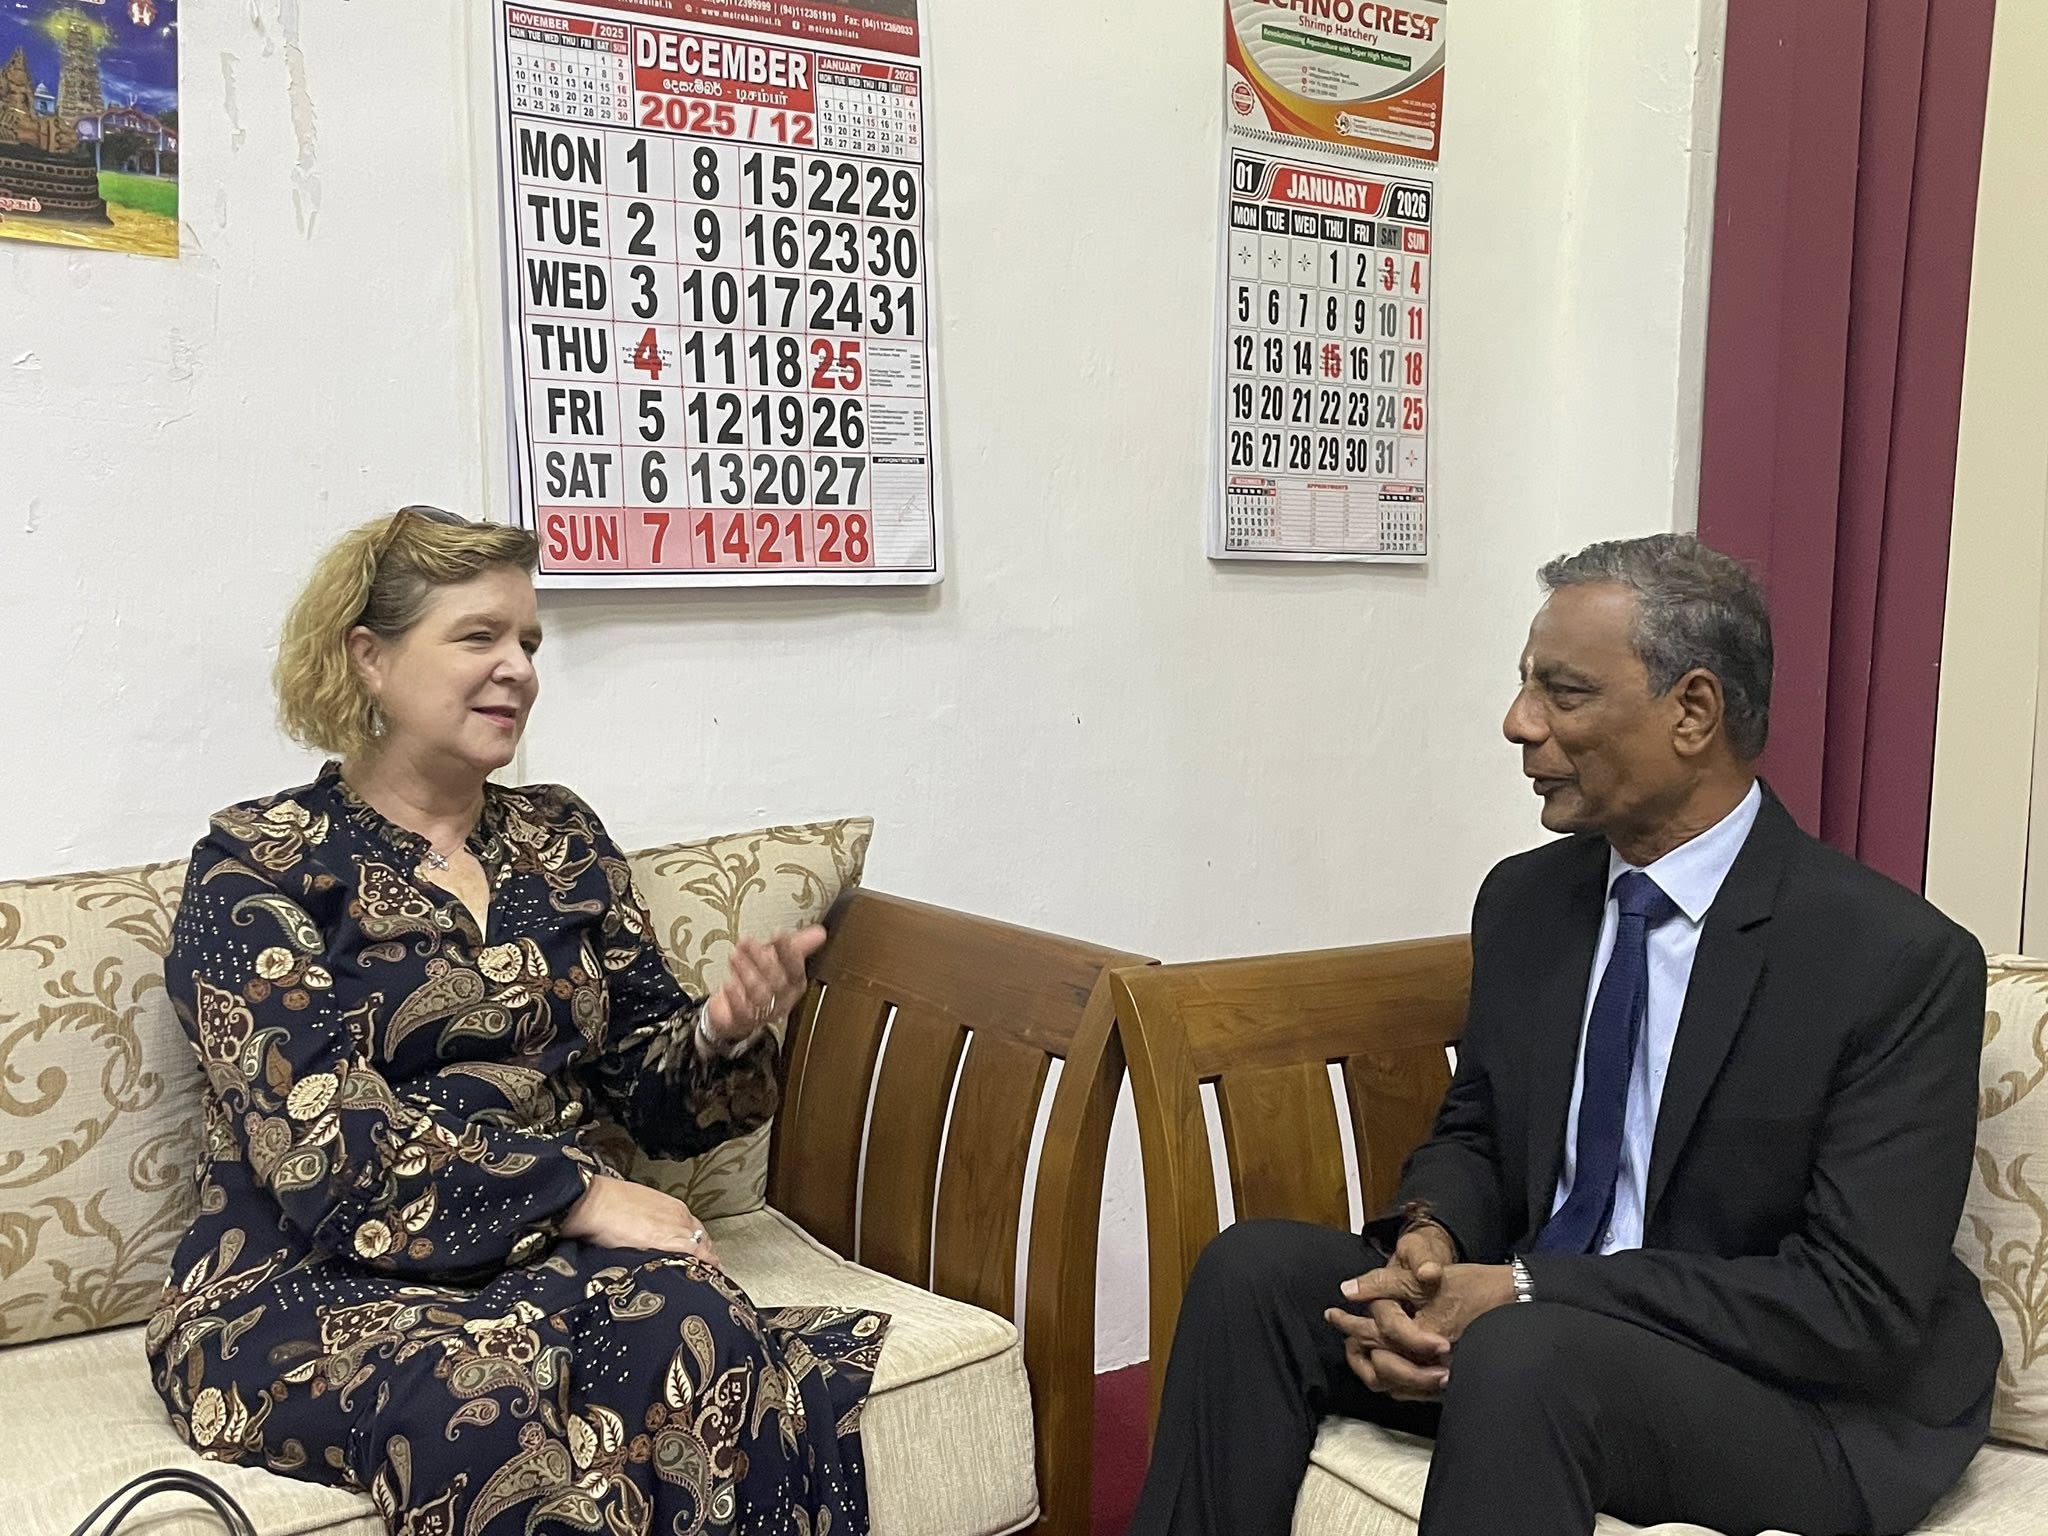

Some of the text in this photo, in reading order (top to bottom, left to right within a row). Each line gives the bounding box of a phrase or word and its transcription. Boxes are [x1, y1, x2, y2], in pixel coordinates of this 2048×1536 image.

[510, 26, 626, 53] MON TUE WED THU FRI SAT SUN
[512, 11, 624, 38] NOVEMBER 2025
[1298, 16, 1378, 46] Shrimp Hatchery
[1358, 2, 1439, 41] CREST
[516, 56, 624, 80] 3 4 5 6 7 8 9
[516, 70, 627, 94] 10 11 12 13 14 15 16
[601, 56, 624, 68] 1 2
[636, 30, 808, 90] DECEMBER
[821, 58, 914, 82] JANUARY 2026
[516, 84, 628, 108] 17 18 19 20 21 22 23
[516, 98, 628, 121] 24 25 26 27 28 29 30
[736, 88, 788, 106] டிசம்பர்
[868, 94, 872, 102] 1
[882, 96, 886, 104] 2
[896, 98, 900, 106] 3
[640, 94, 814, 146] 2025 / 12
[520, 128, 916, 220] MON 1 8 15 22 29
[1236, 161, 1427, 219] 01 JANUARY 2026
[528, 194, 917, 278] TUE 2 9 16 23 30
[1234, 205, 1424, 250] MON TUE WED THU FRI SAT SUN
[1330, 250, 1338, 284] 1
[1356, 253, 1366, 287] 2
[1384, 256, 1394, 290] 3
[1410, 261, 1420, 294] 4
[527, 258, 914, 336] WED 3 10 17 24 31
[1238, 286, 1422, 340] 5 6 7 8 9 10 11
[532, 324, 608, 374] THU
[634, 328, 662, 380] 4
[685, 331, 735, 384] 11
[749, 335, 802, 388] 18
[811, 338, 862, 390] 25
[1234, 335, 1253, 370] 12
[1264, 338, 1283, 373] 13
[1293, 341, 1312, 376] 14
[1322, 344, 1342, 378] 15
[1350, 346, 1368, 381] 16
[1380, 350, 1395, 383] 17
[1404, 352, 1422, 386] 18
[548, 388, 604, 436] FRI
[638, 390, 665, 442] 5
[688, 392, 743, 444] 12
[752, 394, 804, 446] 19
[812, 398, 864, 448] 26
[1232, 384, 1424, 430] 19 20 21 22 23 24 25
[1231, 430, 1394, 474] 26 27 28 29 30 31
[546, 450, 866, 506] SAT 6 13 20 27
[546, 512, 868, 564] SUN 7 14 21 28
